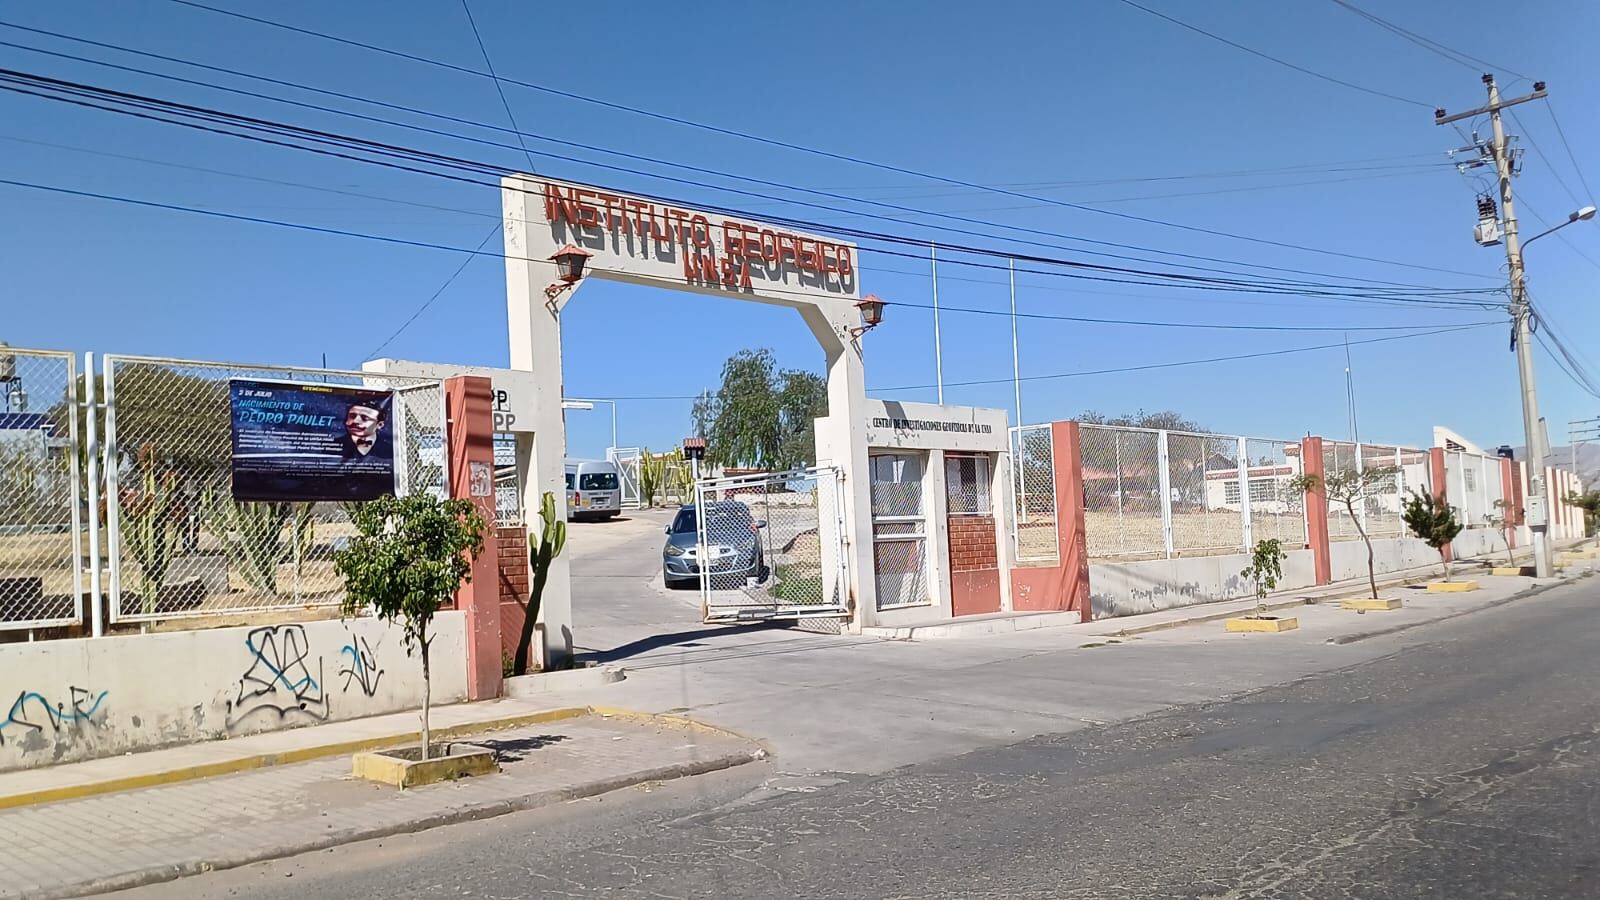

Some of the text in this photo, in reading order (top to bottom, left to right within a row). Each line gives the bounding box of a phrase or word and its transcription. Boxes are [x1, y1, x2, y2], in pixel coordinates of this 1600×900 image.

[544, 182, 851, 275] INSTITUTO GEOFISICO
[254, 390, 273, 398] JULIO
[239, 399, 304, 411] NACIMIENTO DE
[239, 410, 337, 427] PEDRO PAULET
[873, 418, 892, 428] CENTRO
